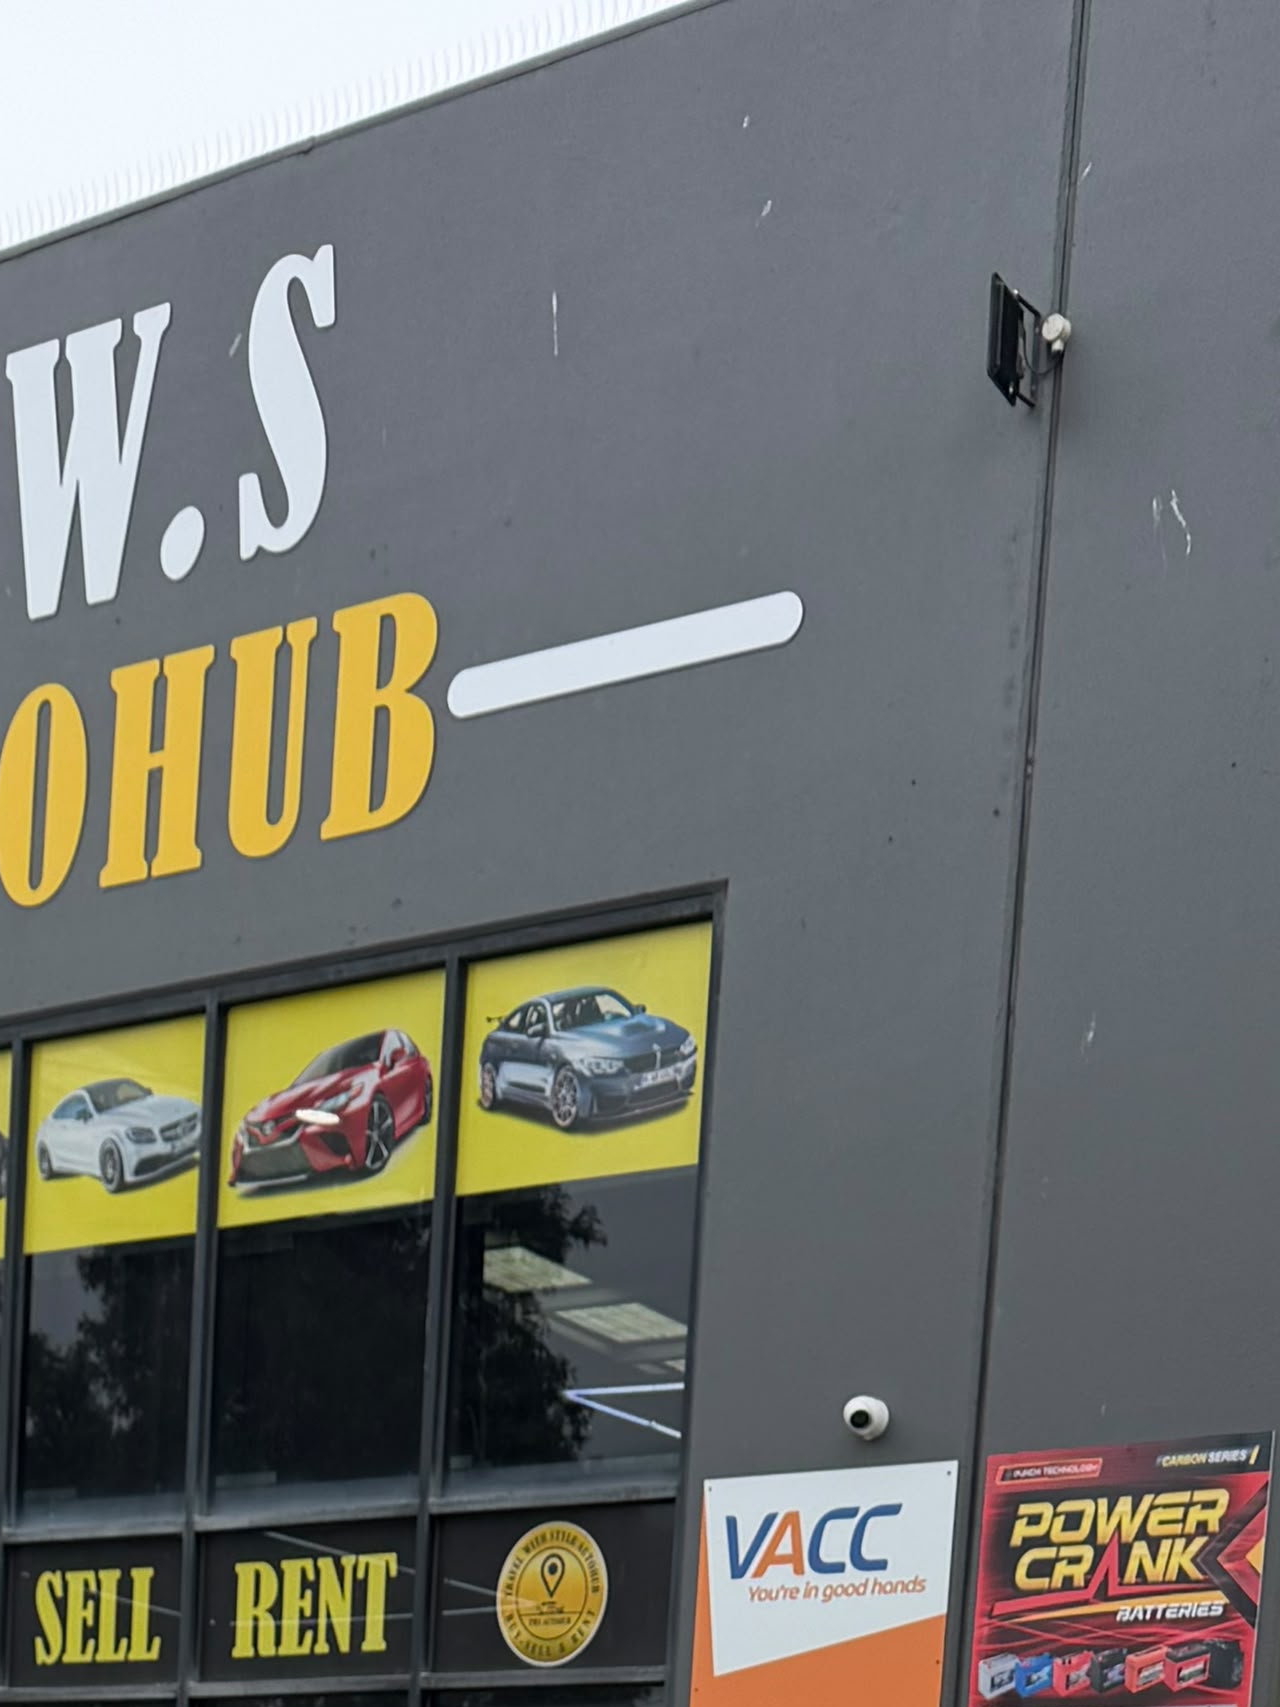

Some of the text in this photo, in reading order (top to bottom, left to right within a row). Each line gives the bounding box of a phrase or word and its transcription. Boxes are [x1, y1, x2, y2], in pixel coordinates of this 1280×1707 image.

[725, 1503, 903, 1580] VACC
[1009, 1488, 1230, 1547] POWER
[34, 1567, 162, 1666] SELL
[231, 1552, 398, 1659] RENT
[748, 1575, 927, 1604] You're in good hands
[1116, 1600, 1225, 1622] BATTERIES
